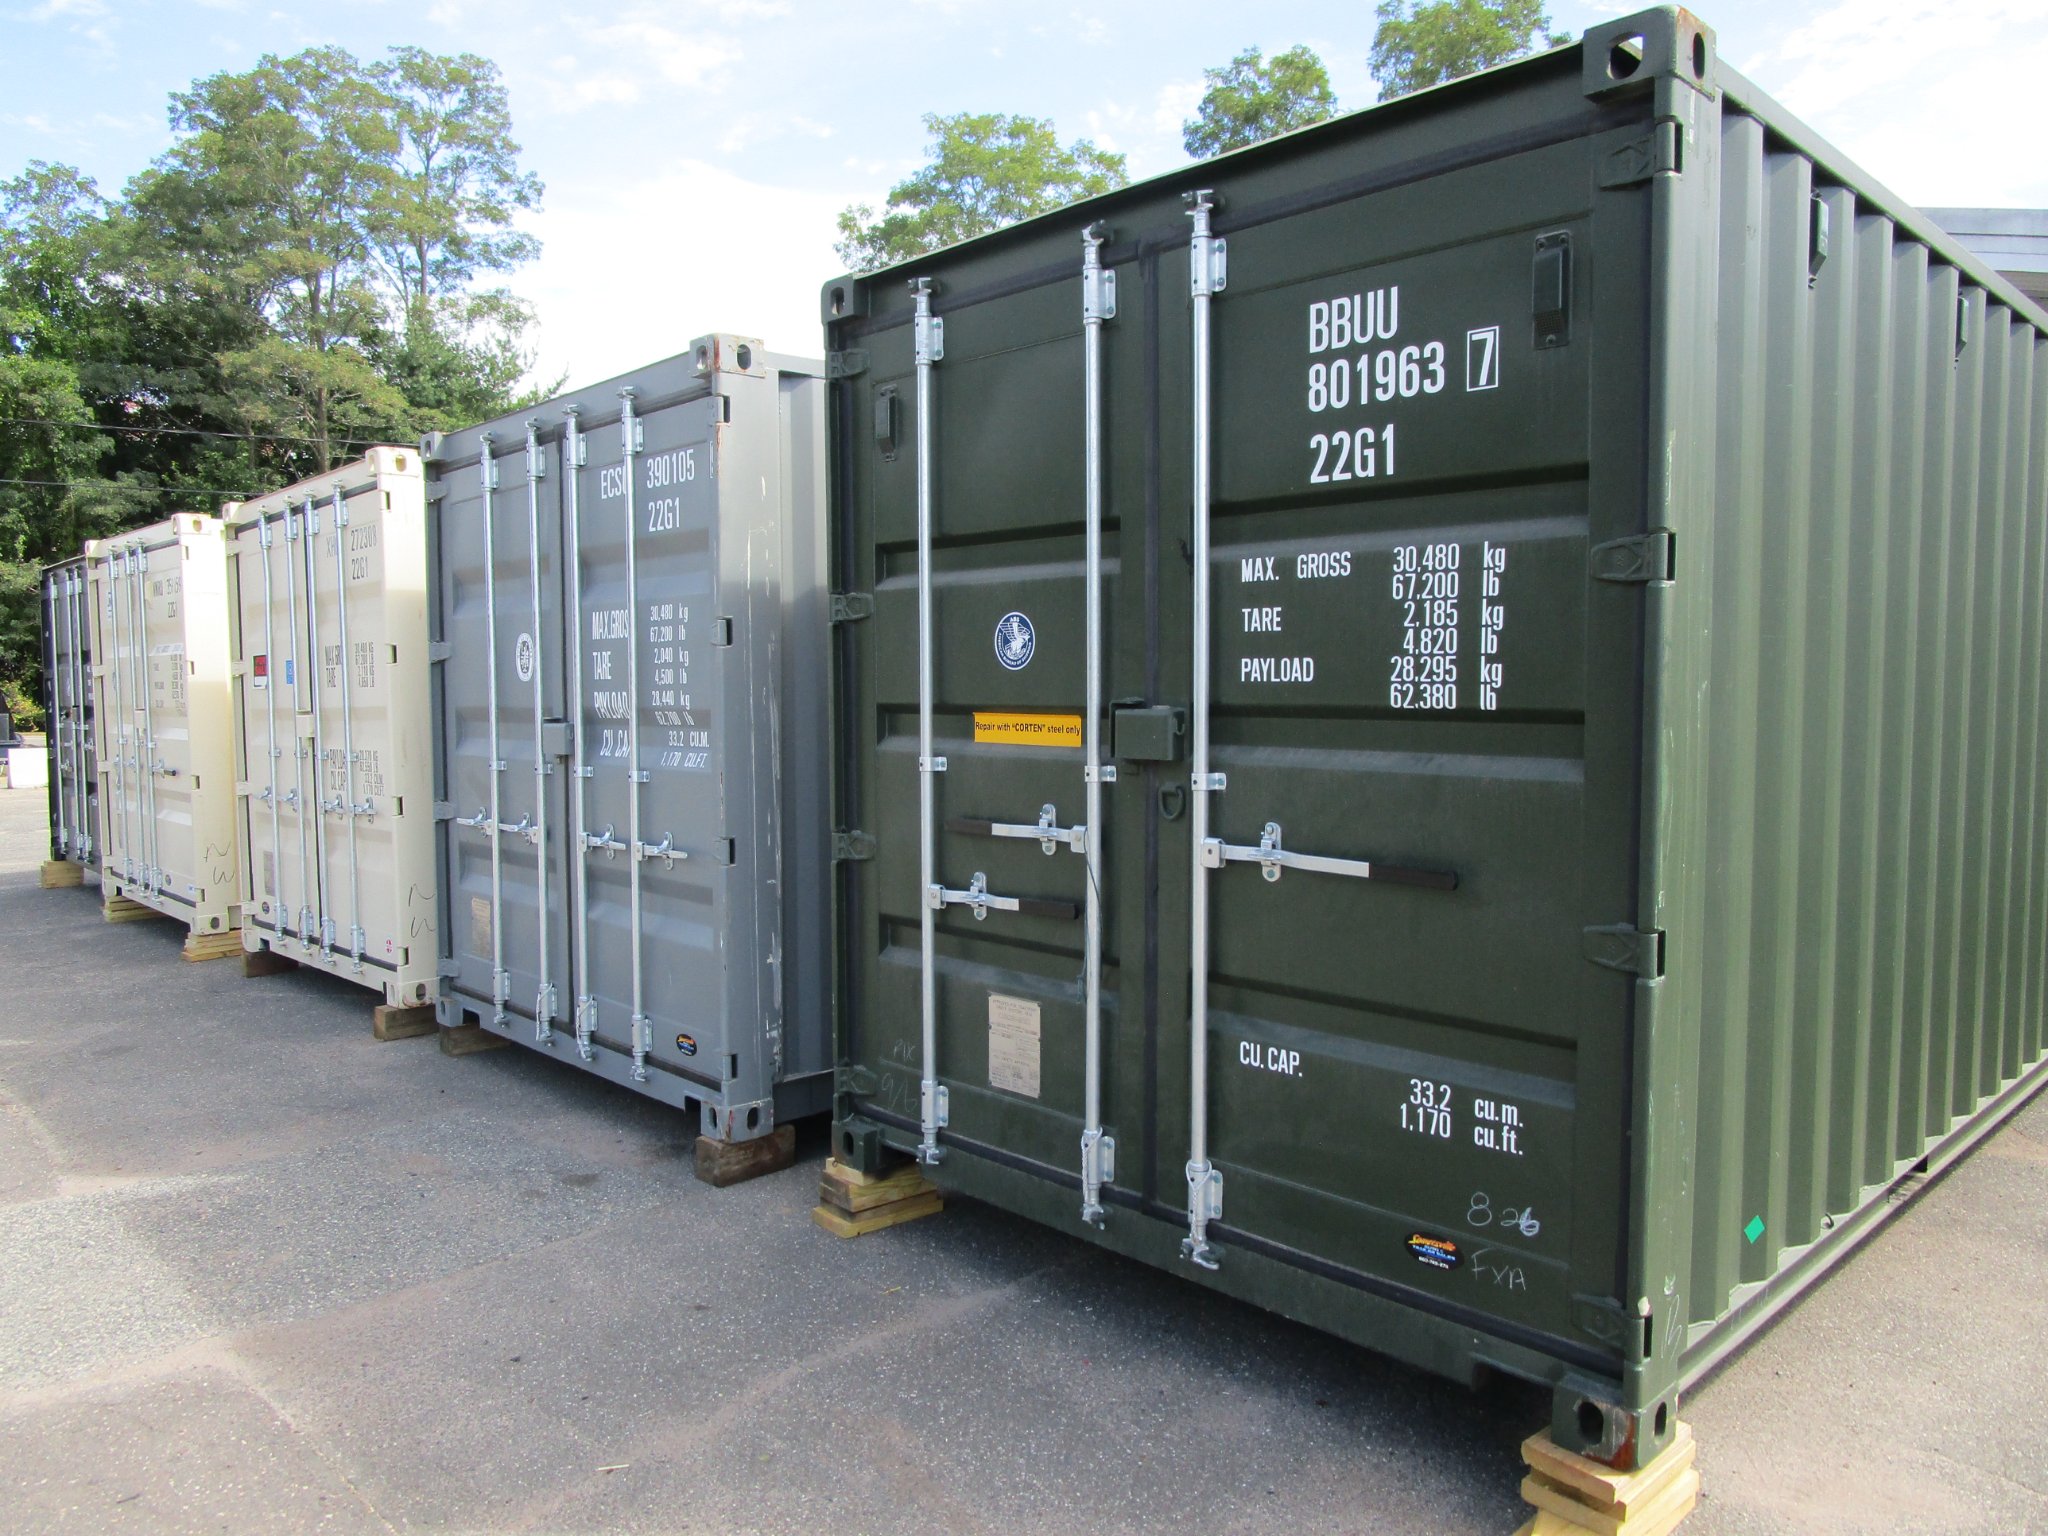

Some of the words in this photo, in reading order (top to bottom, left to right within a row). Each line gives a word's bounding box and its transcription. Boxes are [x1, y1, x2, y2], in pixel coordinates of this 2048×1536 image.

[1309, 286, 1398, 354] BBUU
[1308, 342, 1445, 412] 801963
[1470, 330, 1496, 388] 7
[647, 449, 694, 488] 390105
[1310, 424, 1394, 484] 22G1
[649, 497, 679, 532] 22G1
[1241, 556, 1280, 583] MAX.
[1297, 551, 1351, 580] GROSS
[1393, 543, 1460, 573] 30,480
[1483, 541, 1505, 572] kg
[1392, 572, 1459, 601] 67,200
[1483, 575, 1499, 597] lb
[592, 610, 629, 640] MAX.GROS
[679, 603, 688, 623] kg
[1242, 607, 1282, 632] TARE
[1404, 600, 1458, 628] 2,185
[1482, 599, 1504, 630] kg
[679, 625, 686, 641] lb
[1403, 628, 1457, 655] 4,820
[1481, 630, 1498, 654] lb
[593, 651, 612, 680] TARE
[679, 647, 689, 667] kg
[680, 668, 687, 685] lb
[1241, 658, 1314, 682] PAYLOAD
[1390, 655, 1457, 684] 28,295
[1480, 657, 1502, 687] kg
[680, 690, 690, 710] kg
[1390, 684, 1457, 710] 62,380
[1480, 685, 1497, 710] lb
[683, 712, 695, 726] lb
[976, 722, 995, 732] Repair
[997, 723, 1011, 731] with
[1047, 725, 1064, 734] steel
[1066, 726, 1080, 736] only
[615, 730, 630, 757] CA
[669, 731, 684, 747] 33.2
[1410, 1079, 1451, 1112] 33.2
[1400, 1103, 1451, 1138] 1,170
